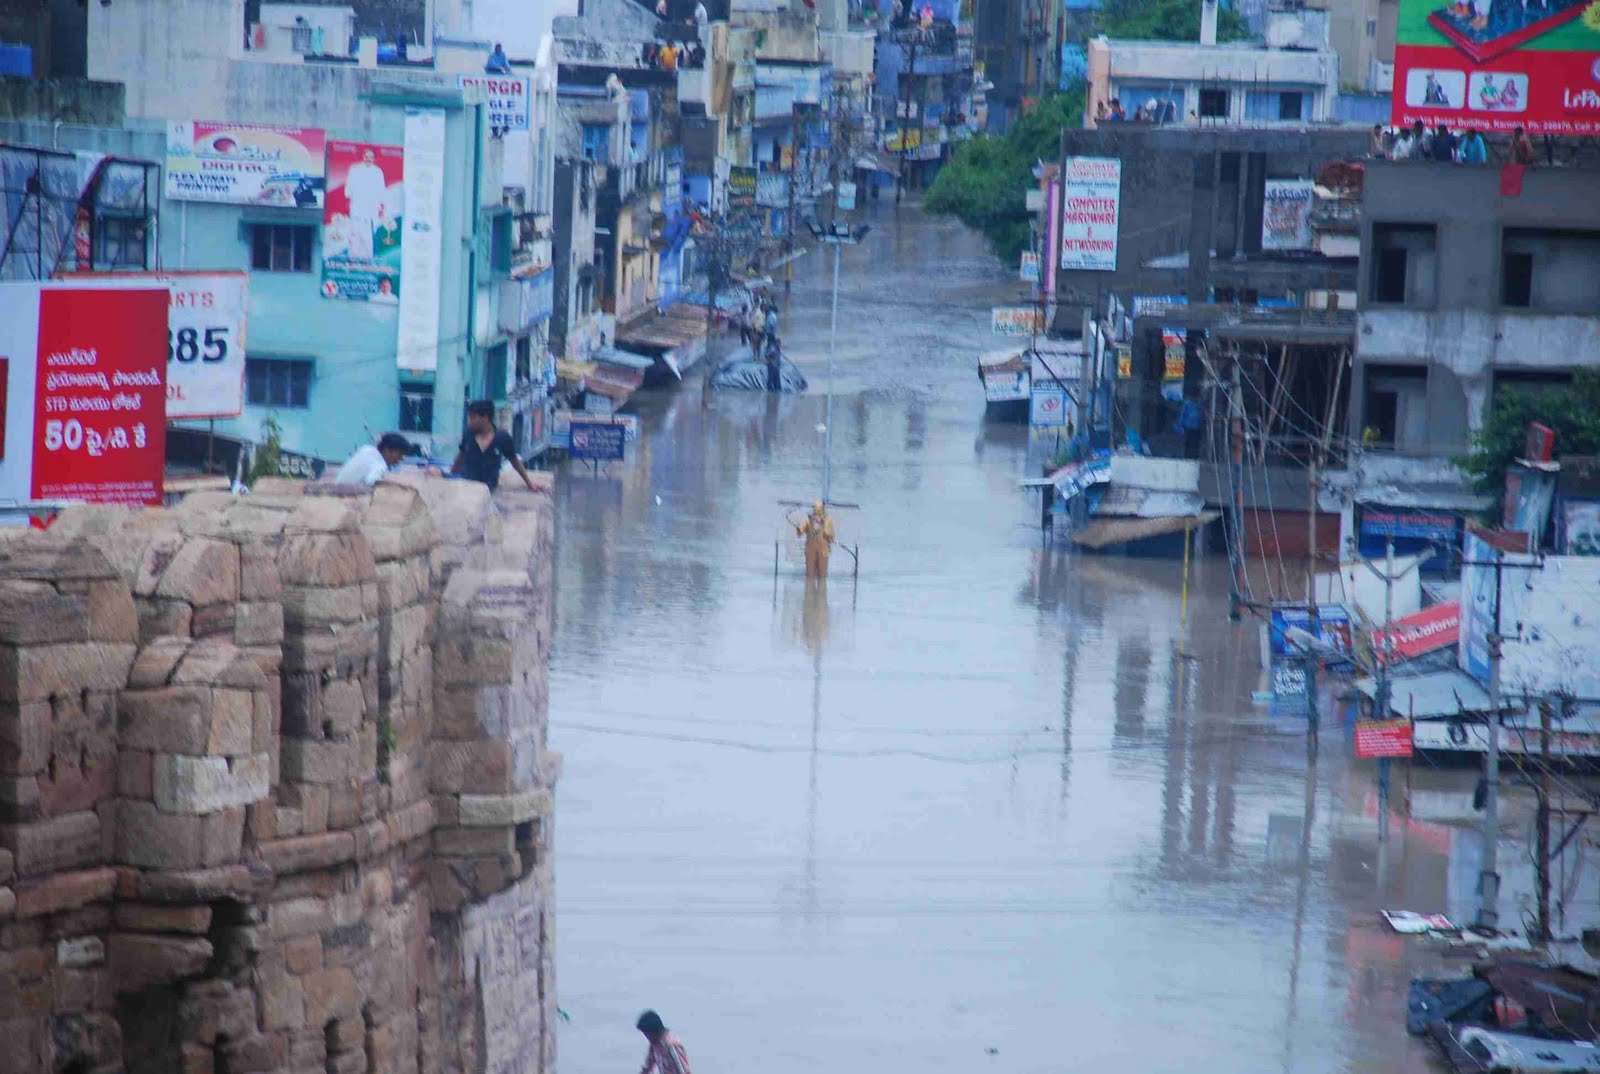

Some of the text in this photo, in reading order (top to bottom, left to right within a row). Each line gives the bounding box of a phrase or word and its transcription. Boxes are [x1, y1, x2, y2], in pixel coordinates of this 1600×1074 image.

[177, 182, 229, 193] PRINTING
[1067, 199, 1115, 211] COMPUTER
[1064, 212, 1116, 225] HARDWARE
[1064, 239, 1114, 252] NETWORKING
[168, 291, 213, 307] RTS
[45, 396, 68, 412] STD
[45, 418, 83, 451] 50
[1400, 616, 1459, 643] vodafone
